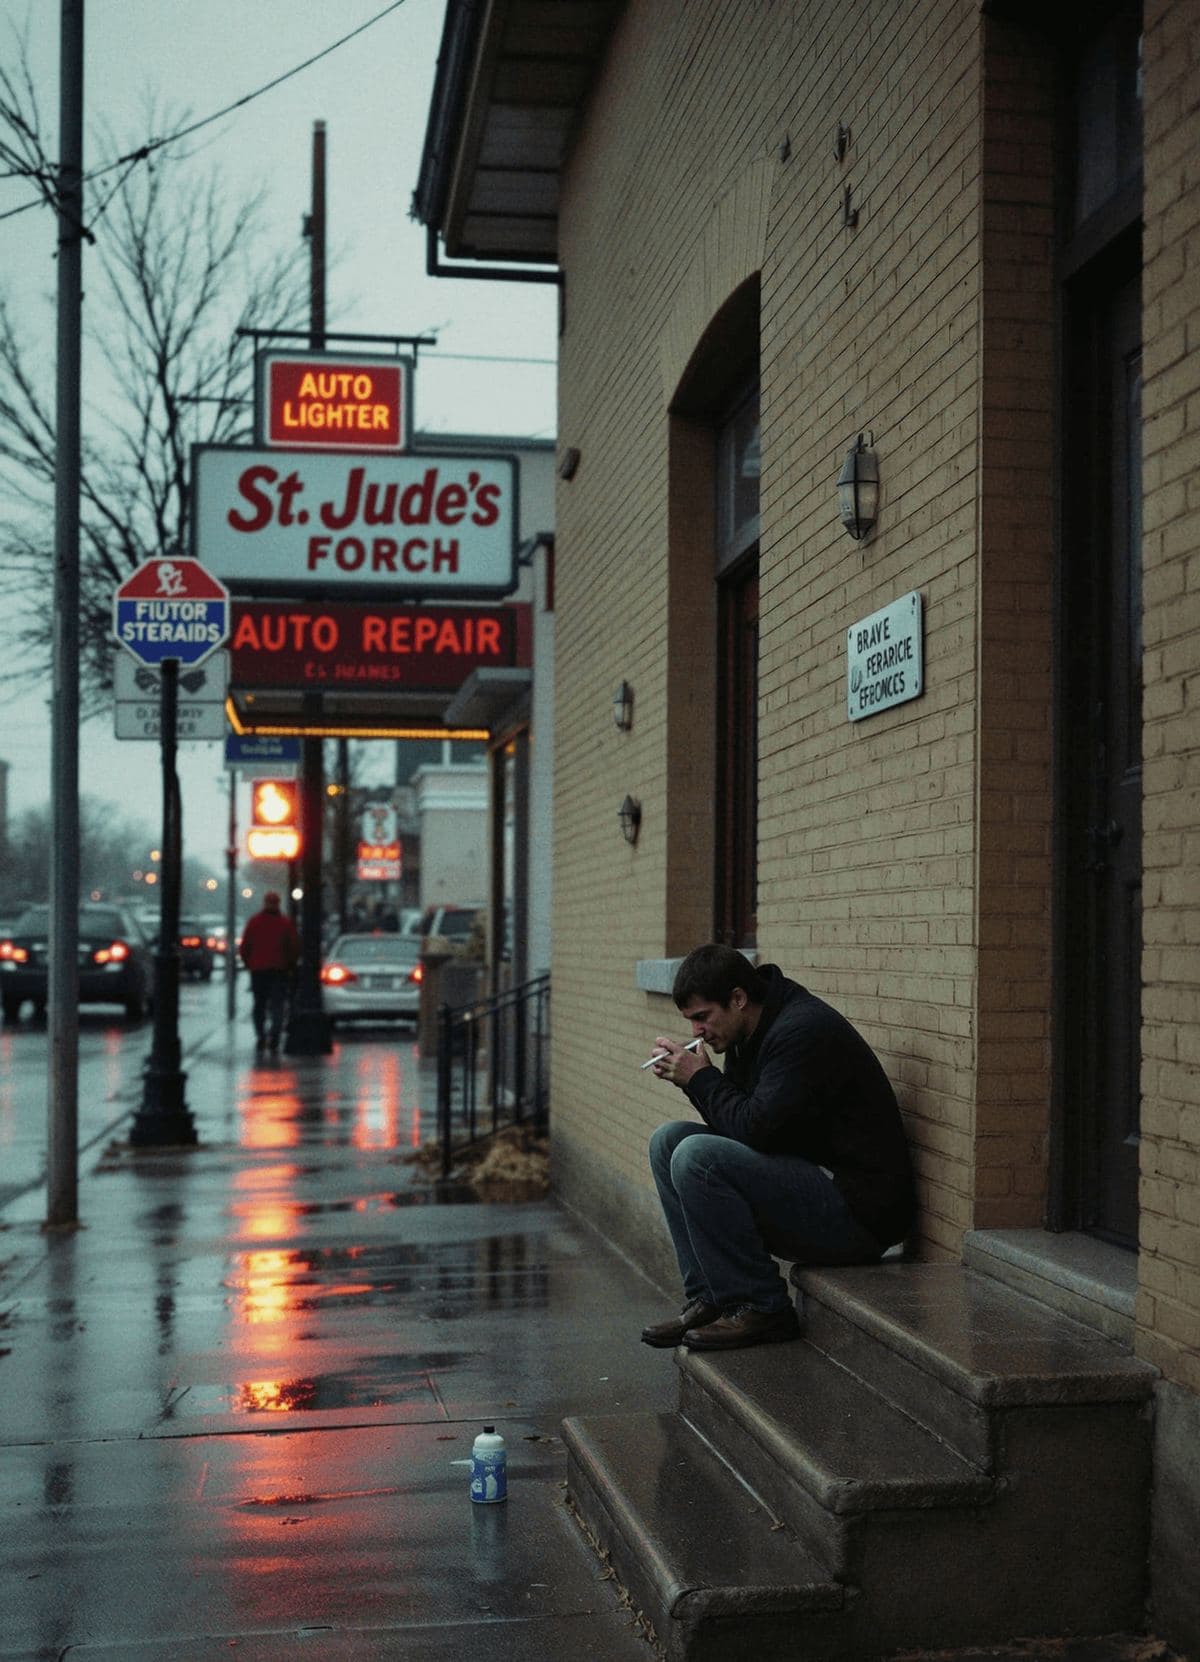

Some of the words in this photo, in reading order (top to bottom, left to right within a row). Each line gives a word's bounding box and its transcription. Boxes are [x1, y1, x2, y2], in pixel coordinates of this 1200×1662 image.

[299, 372, 373, 399] AUTO
[283, 402, 390, 430] LIGHTER
[227, 464, 310, 533] St.
[320, 466, 502, 531] Jude's
[306, 536, 460, 574] FORCH
[122, 621, 221, 643] STERAIDS
[232, 614, 339, 653] AUTO
[362, 616, 501, 655] REPAIR
[856, 616, 891, 655] BRAVE
